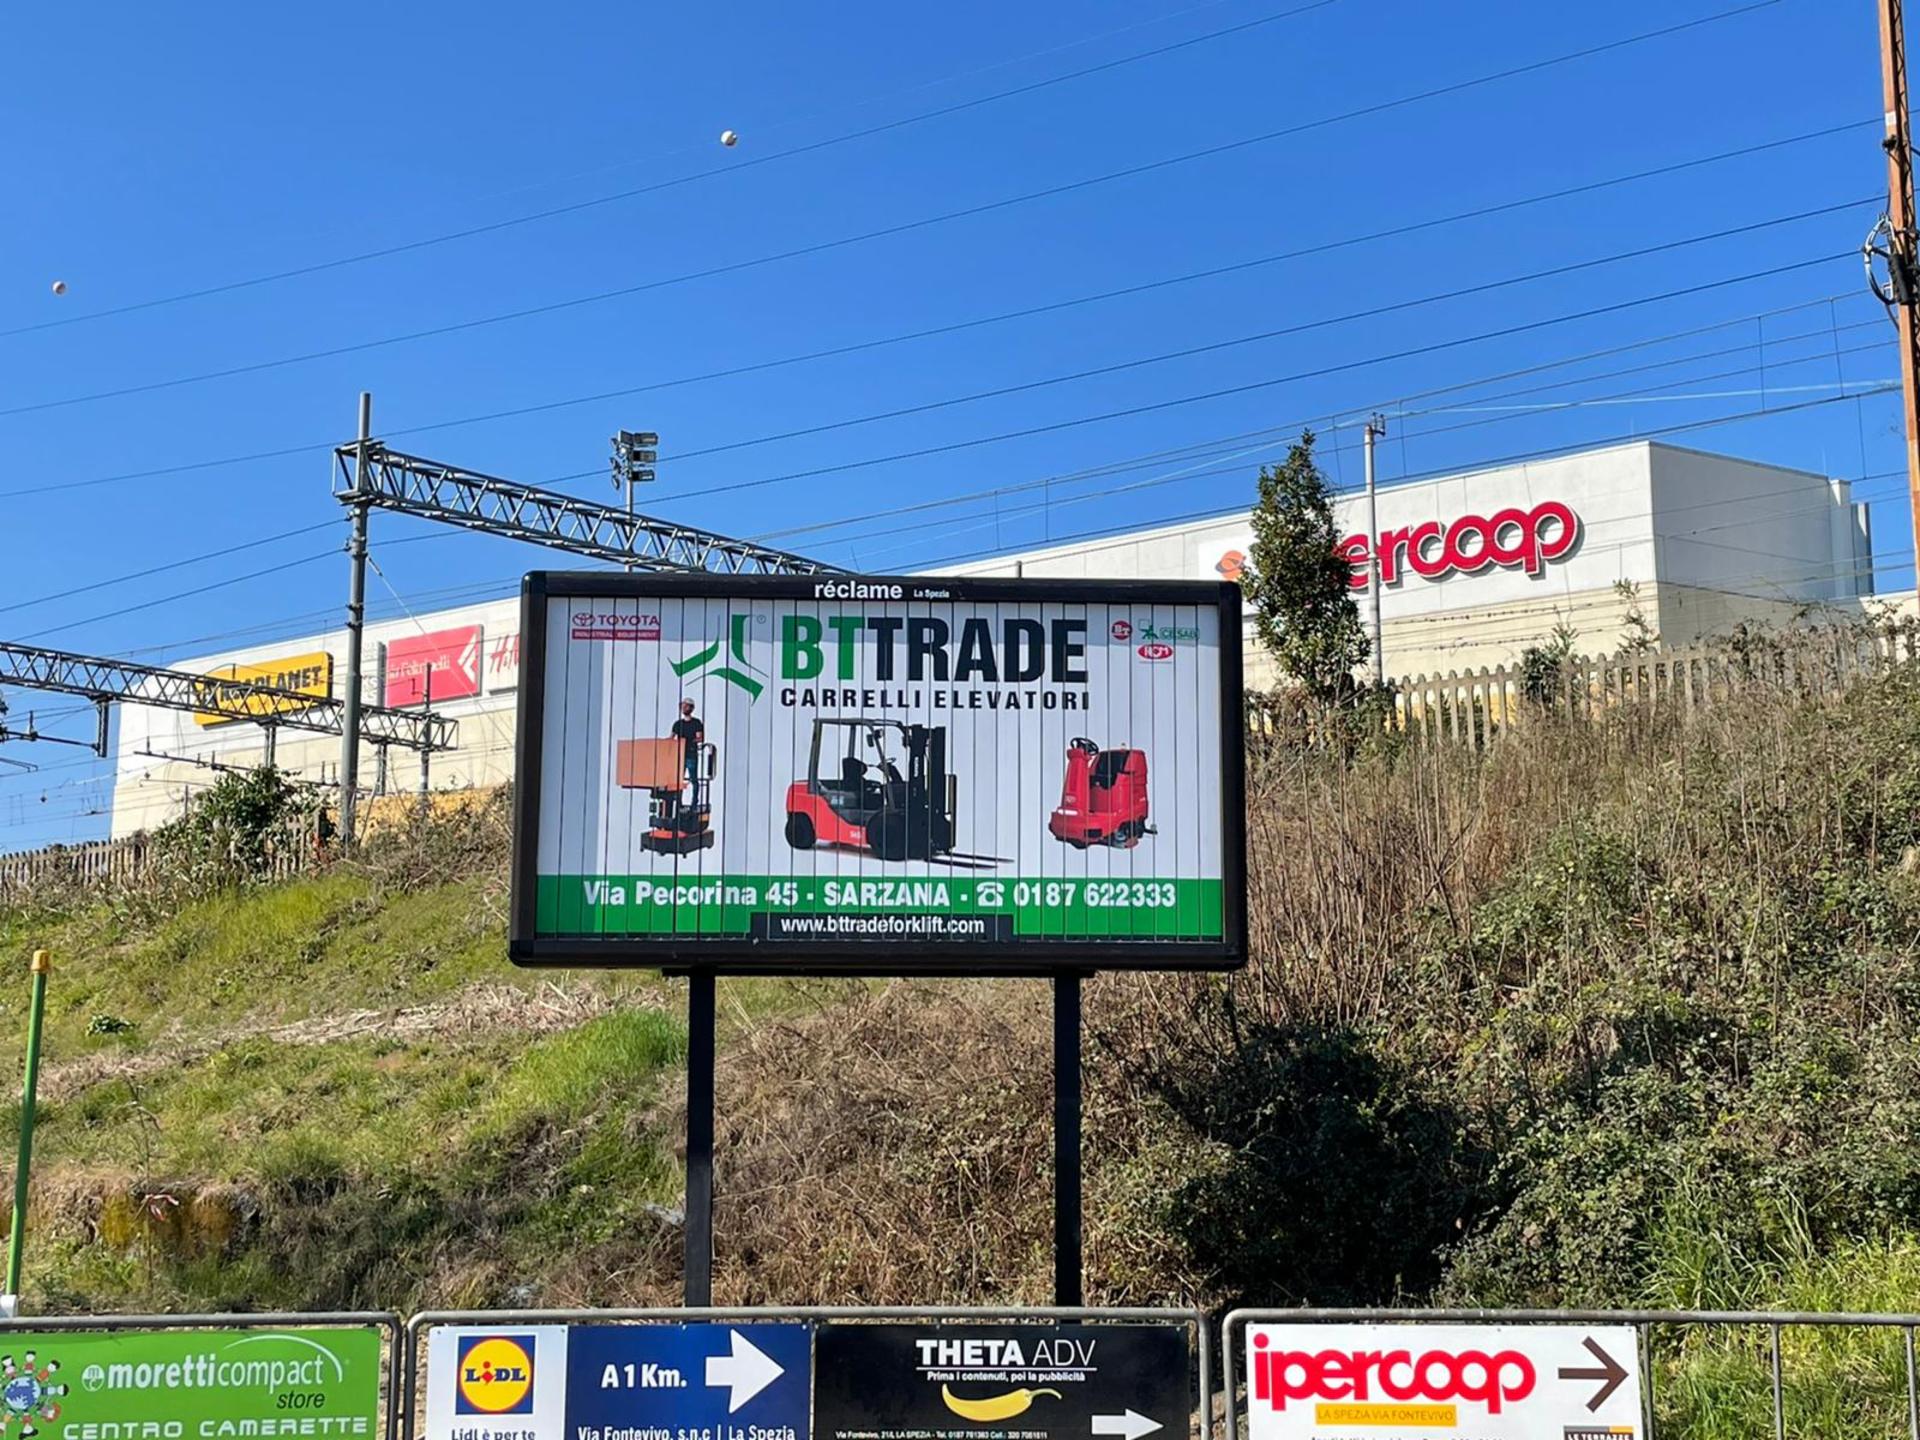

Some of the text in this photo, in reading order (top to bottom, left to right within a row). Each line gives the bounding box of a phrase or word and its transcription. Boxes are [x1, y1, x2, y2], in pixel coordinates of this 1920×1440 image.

[1334, 501, 1577, 589] ercoop
[814, 580, 903, 599] réclame
[598, 614, 660, 626] TOYOTA
[781, 614, 1089, 683] BTTRADE
[780, 688, 1089, 710] CARRELLI ELEVATORI
[584, 880, 625, 906] Via
[635, 880, 757, 906] Pecorina
[765, 881, 798, 906] 45
[823, 881, 950, 907] SARZANA
[1013, 882, 1077, 907] 0187
[1083, 882, 1177, 908] 622333
[780, 915, 985, 934] www.bttradeforklift.com
[916, 1339, 1096, 1366] THETA ADV
[107, 1353, 324, 1395] moretticompact
[600, 1363, 687, 1388] A 1 Km.
[927, 1371, 954, 1381] Prima
[1254, 1333, 1536, 1414] ipercoop
[276, 1391, 326, 1410] store
[1318, 1408, 1454, 1421] LA SPEZIA VIA FONTEVIVO
[63, 1416, 368, 1440] CENTRO CAMERETTE
[451, 1428, 478, 1440] Lidl
[578, 1426, 600, 1440] Via
[728, 1426, 744, 1440] La
[748, 1425, 795, 1440] Spezia
